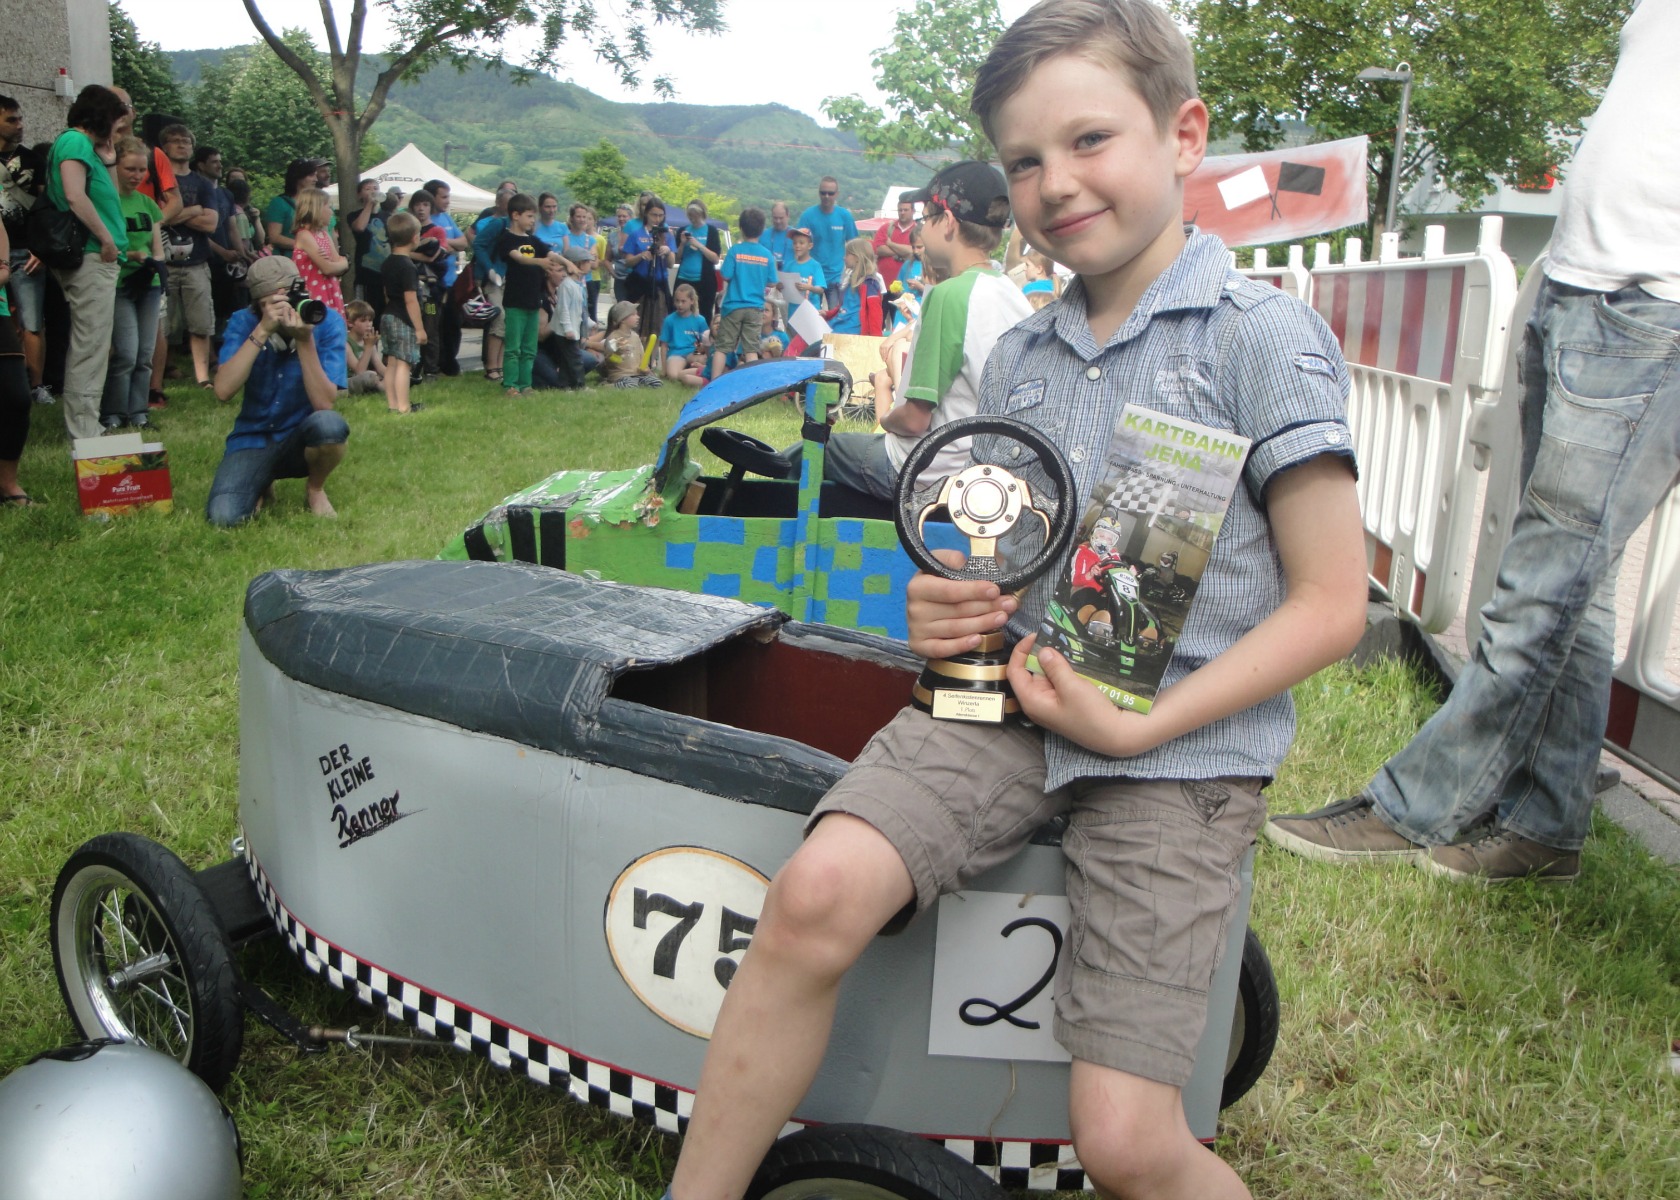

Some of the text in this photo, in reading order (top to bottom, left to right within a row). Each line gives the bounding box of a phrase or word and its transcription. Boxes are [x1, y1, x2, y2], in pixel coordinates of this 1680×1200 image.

[1124, 412, 1244, 460] KARTBAHN
[1144, 443, 1202, 473] JENA
[1146, 471, 1177, 486] SPANNUNG
[1180, 483, 1227, 502] UNTERHALTUNG
[1109, 689, 1121, 701] 01
[1122, 694, 1136, 706] 95
[318, 743, 354, 776] DER
[327, 756, 376, 804] KLEINE
[330, 789, 401, 840] Renner
[632, 886, 760, 991] 75
